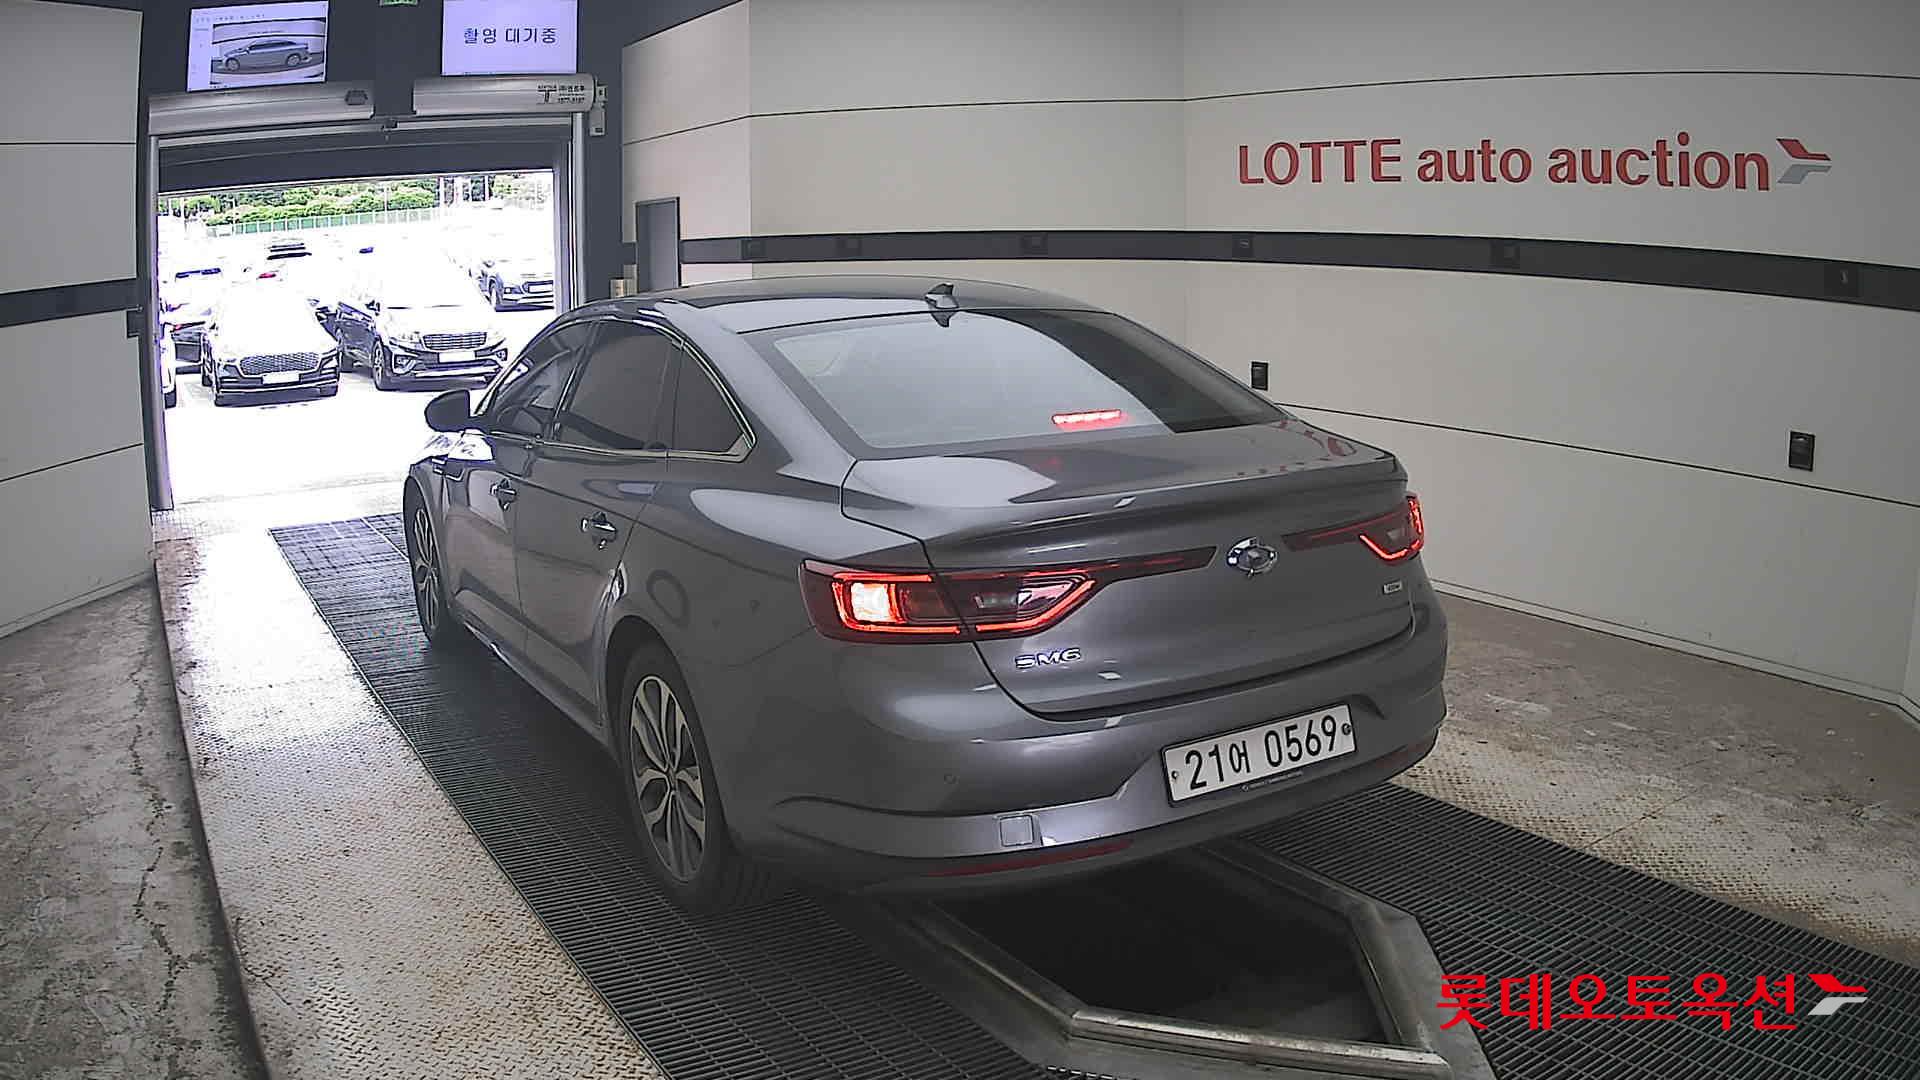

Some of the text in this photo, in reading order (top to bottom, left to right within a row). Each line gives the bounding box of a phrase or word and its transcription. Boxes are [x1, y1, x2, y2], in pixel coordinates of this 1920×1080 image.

[464, 27, 557, 44] 촬영 대기중
[1239, 131, 1770, 191] LOTTE auto auction
[1014, 647, 1082, 669] SM6
[1184, 740, 1251, 791] 21어
[1264, 715, 1337, 768] 0569
